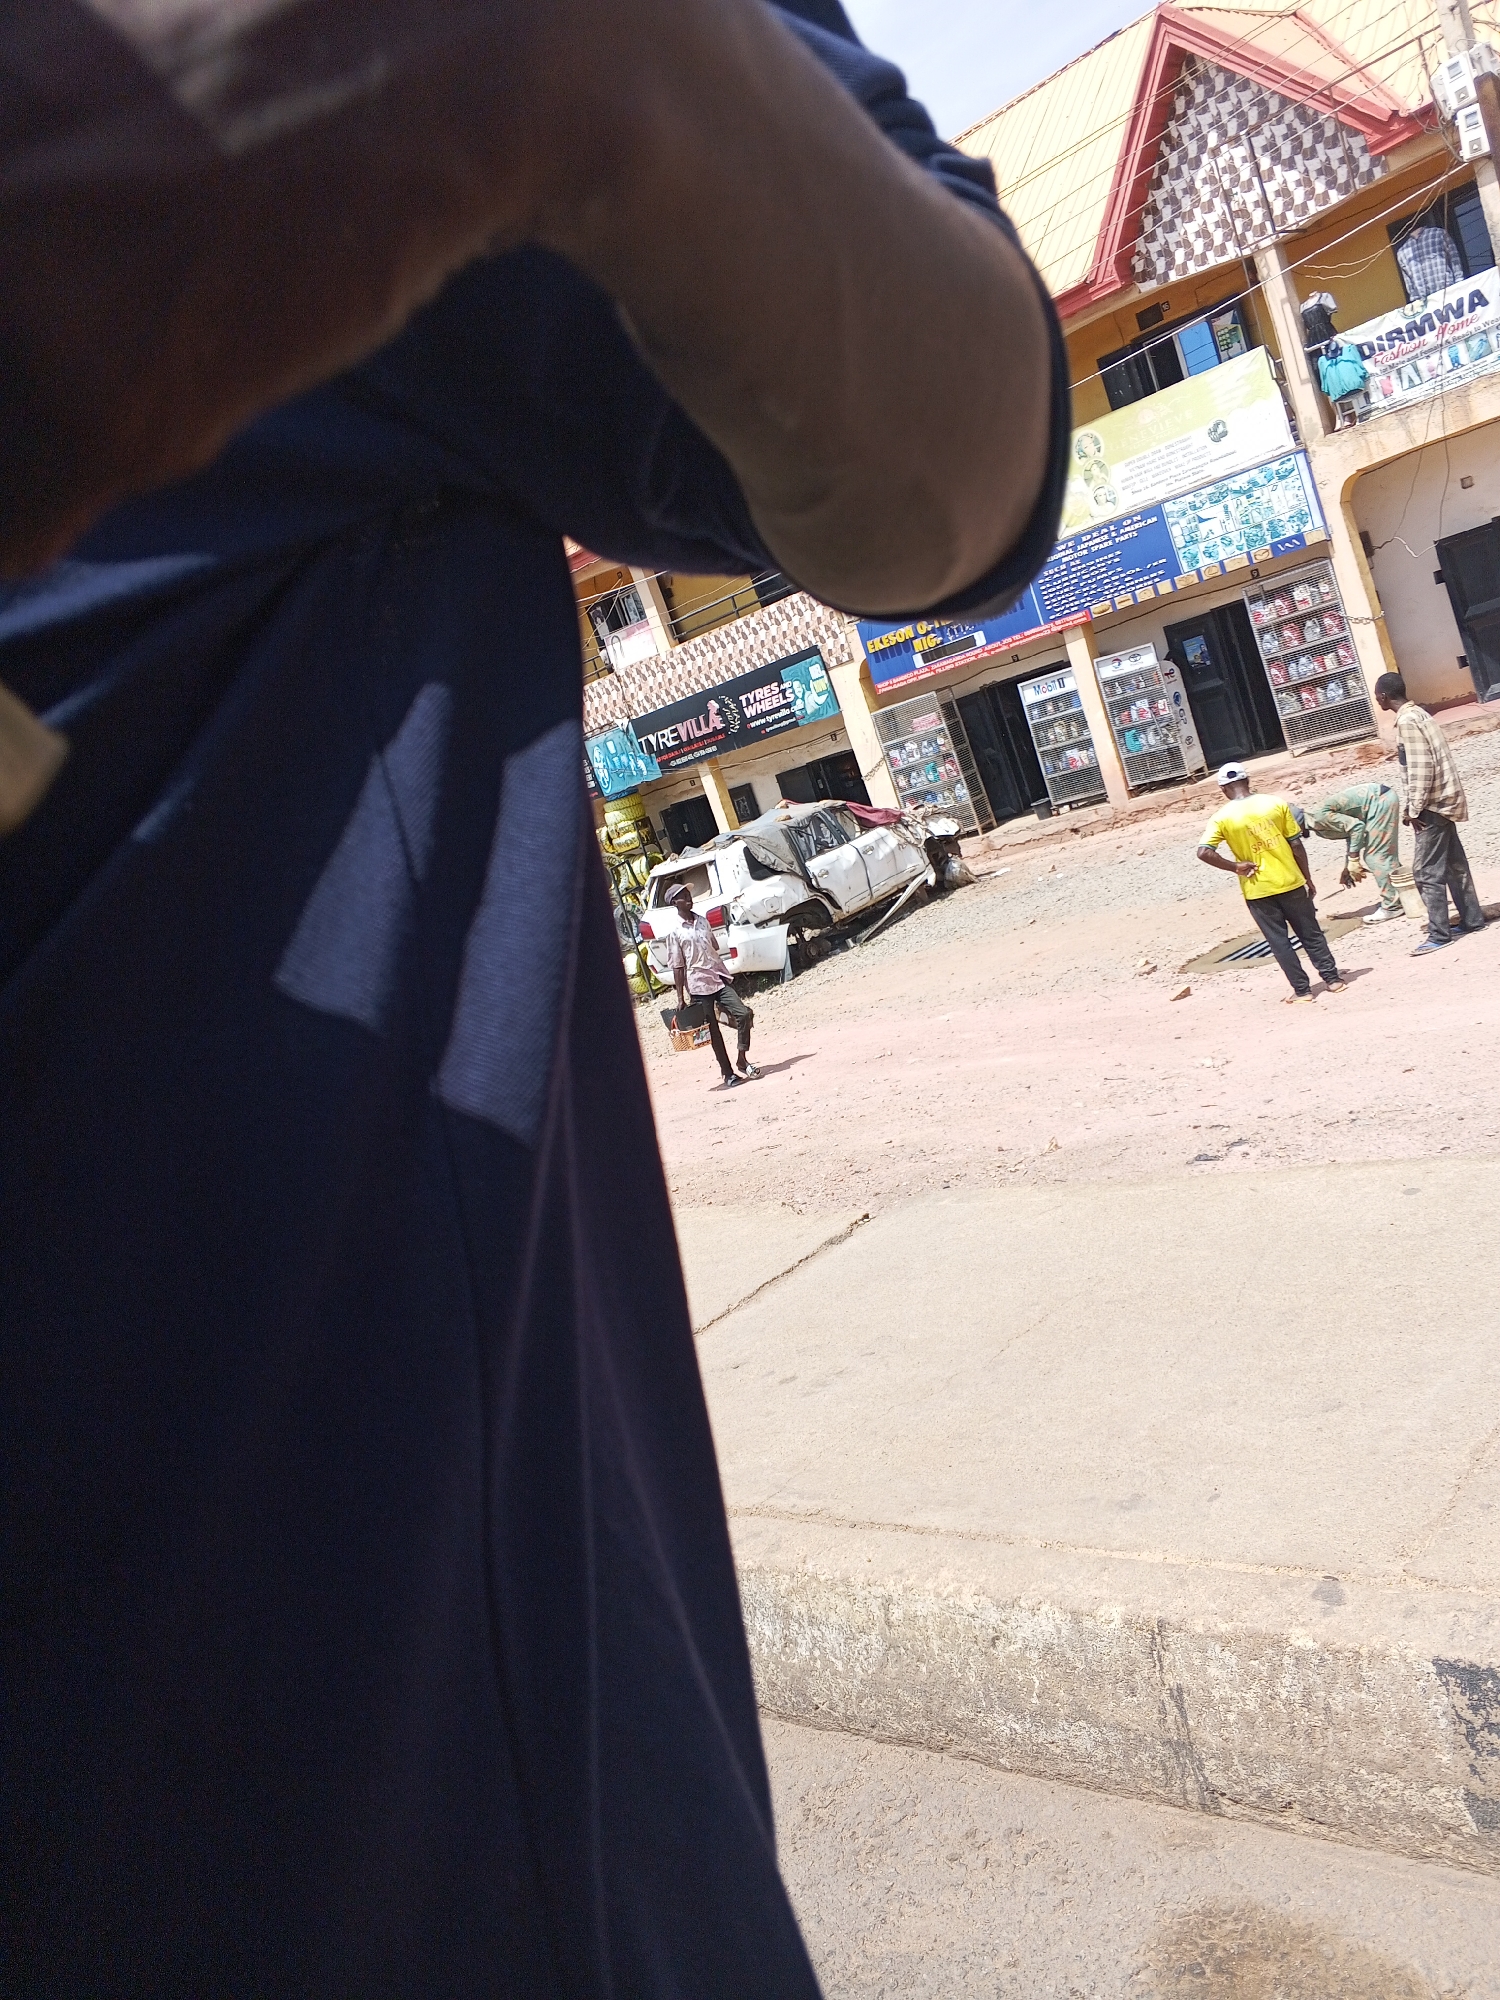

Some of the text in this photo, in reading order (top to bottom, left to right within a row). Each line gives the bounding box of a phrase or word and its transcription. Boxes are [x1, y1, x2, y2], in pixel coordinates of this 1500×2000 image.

[1373, 314, 1480, 367] Fashion Home
[1419, 341, 1443, 356] Femal
[1482, 315, 1500, 327] Wea
[1046, 548, 1074, 562] RIGINAL
[1076, 534, 1109, 550] JAPANESE
[1119, 516, 1157, 534] AMERICAN
[1055, 514, 1141, 552] WE DEAL ON
[1061, 530, 1138, 563] MOTOR SPARE PARTS
[1042, 558, 1081, 576] SUCH AS
[1071, 550, 1122, 572] ENGINES
[1082, 567, 1107, 579] BOX
[1079, 566, 1123, 586] PUMPS
[1082, 580, 1120, 597] JACKS
[1053, 569, 1165, 612] WHEEL SPANNERS
[1082, 577, 1160, 607] ACCESSORIES
[866, 625, 914, 653] EKESON
[912, 634, 942, 653] NIG.
[738, 682, 778, 707] TYRES
[1033, 680, 1057, 696] Mobil
[743, 689, 795, 718] WHEELS
[638, 706, 725, 756] TYREVILLA
[1251, 833, 1281, 853] SPIRIT
